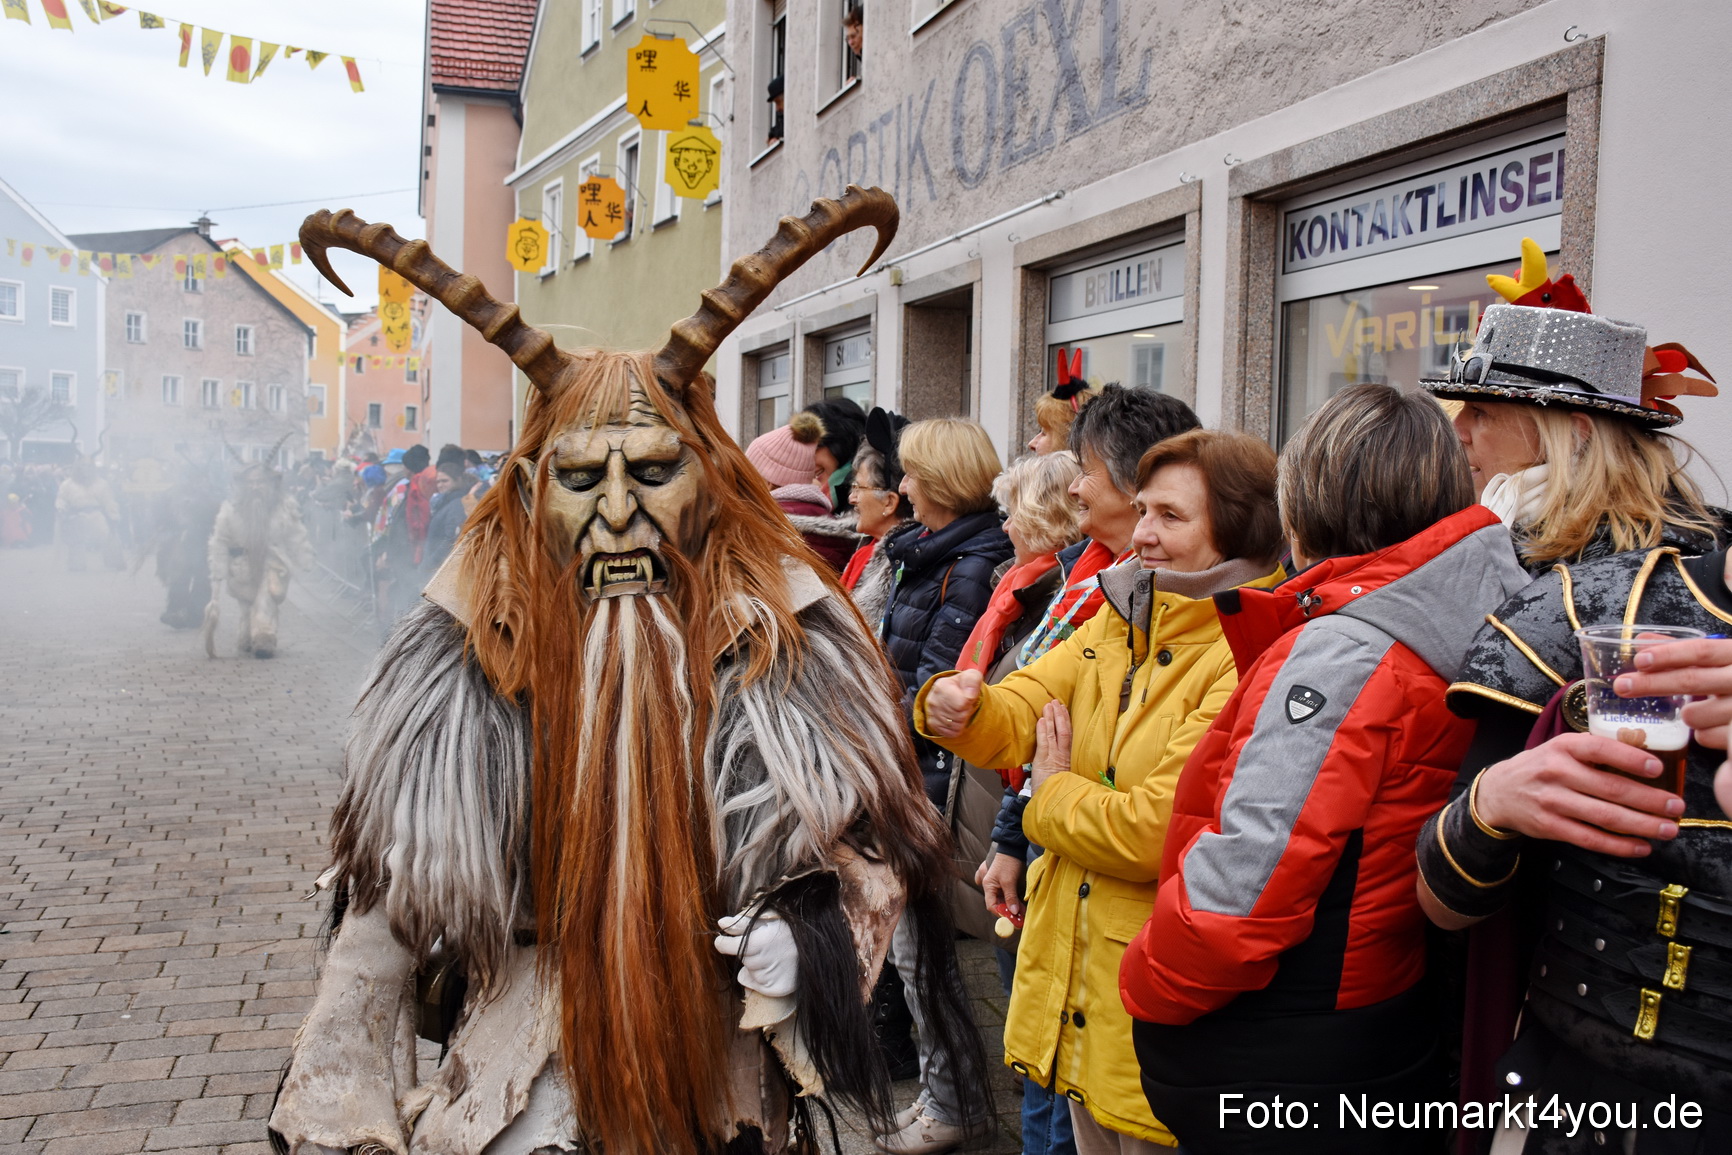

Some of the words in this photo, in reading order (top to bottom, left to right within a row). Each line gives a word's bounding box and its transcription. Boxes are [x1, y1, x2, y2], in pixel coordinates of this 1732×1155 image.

[952, 0, 1156, 190] OEXL
[637, 99, 653, 117] 人
[583, 209, 598, 228] 人
[1085, 256, 1163, 309] BRILLEN
[1602, 711, 1633, 724] Liebe
